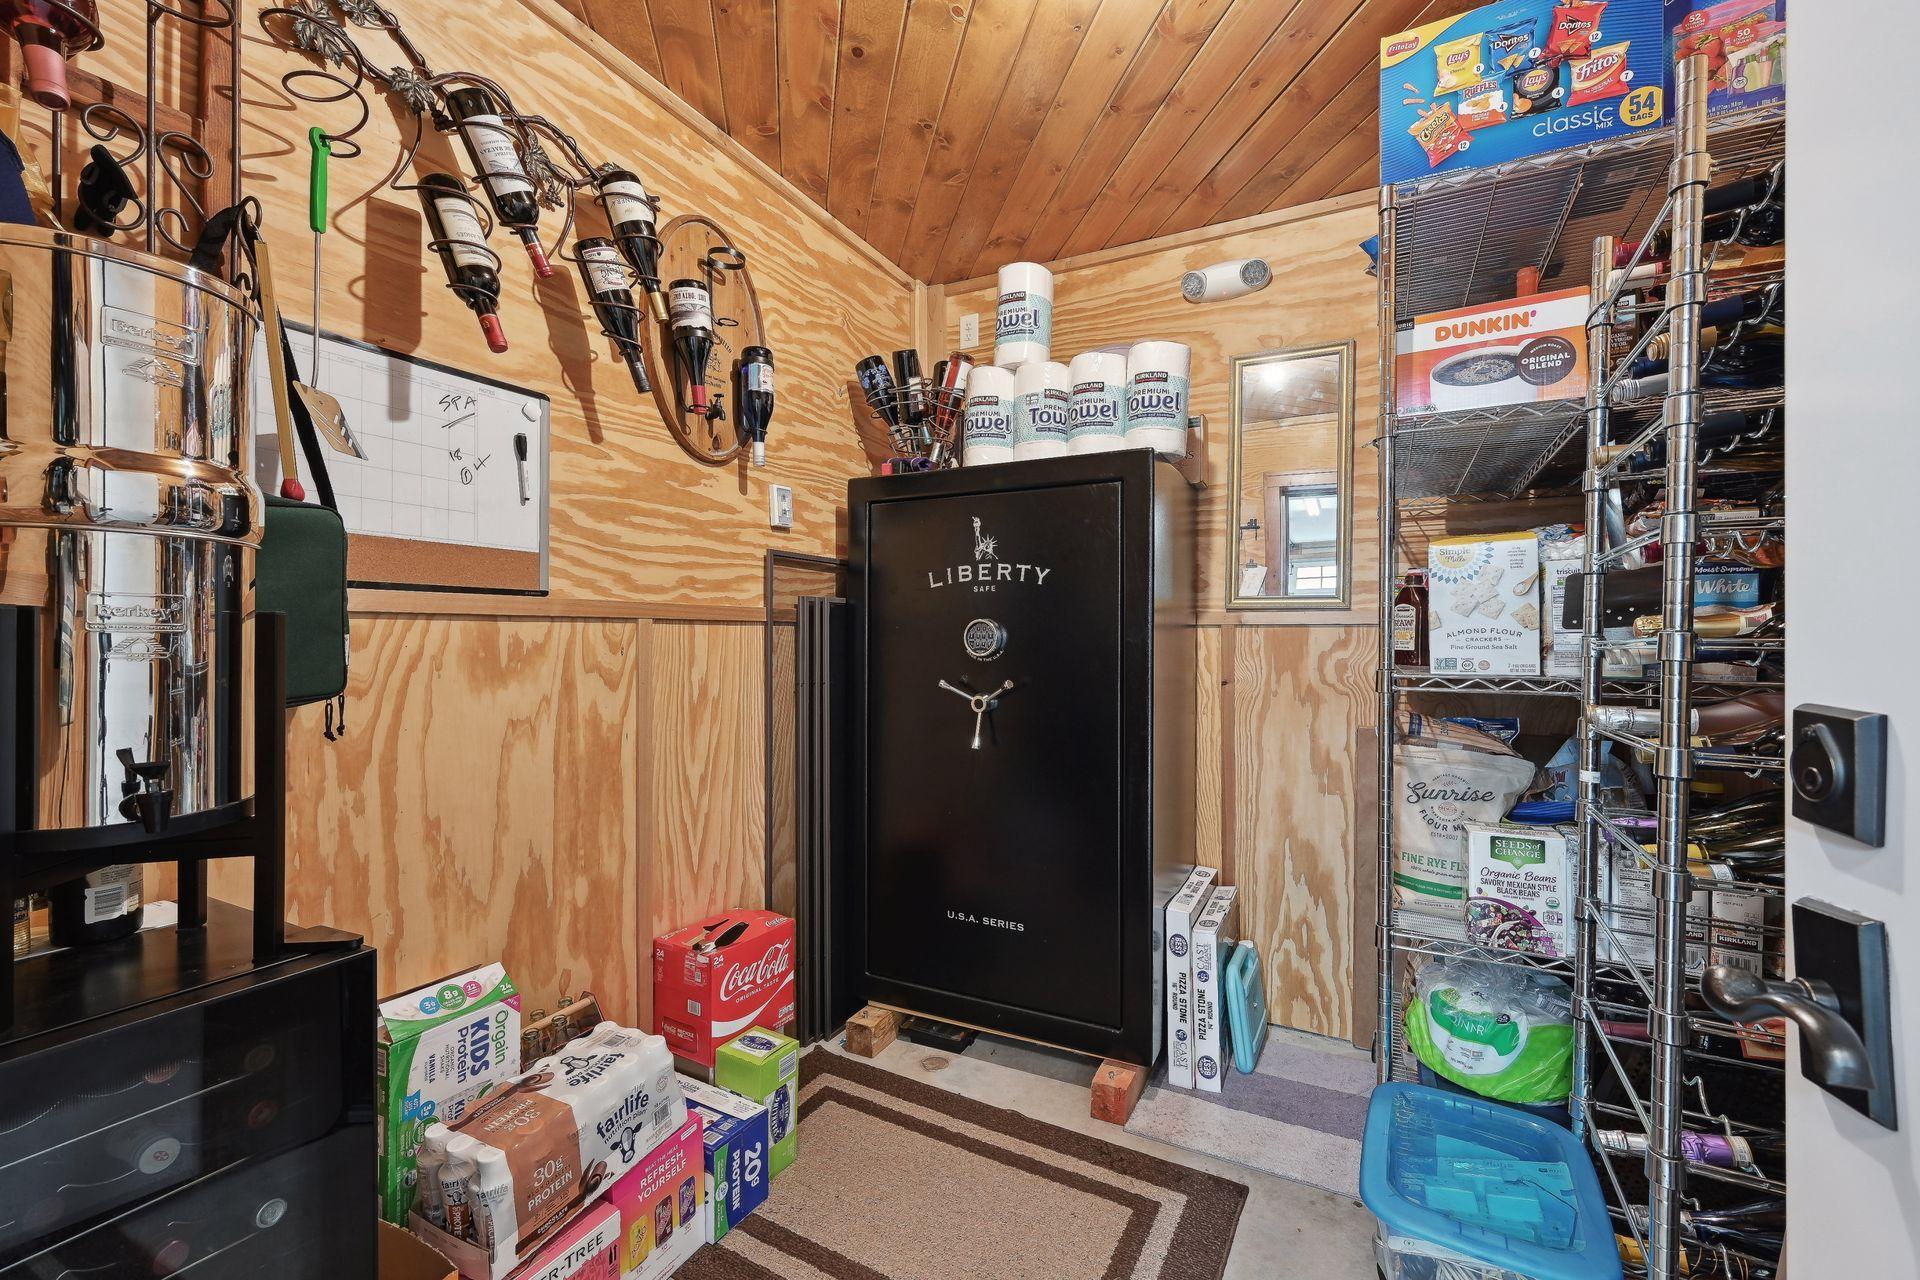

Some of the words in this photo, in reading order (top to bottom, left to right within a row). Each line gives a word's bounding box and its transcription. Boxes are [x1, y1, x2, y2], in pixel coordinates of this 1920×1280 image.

[1558, 20, 1592, 31] Doritos
[1689, 13, 1702, 22] 52
[1494, 33, 1529, 50] Doritos
[1591, 32, 1599, 41] 12
[1737, 28, 1751, 38] 50
[1577, 52, 1620, 82] Fritos
[1628, 91, 1656, 115] 54
[1532, 106, 1614, 138] classic
[1595, 121, 1613, 130] MIX
[1630, 111, 1654, 122] BAGS
[1521, 352, 1571, 365] ORIGINAL
[1529, 360, 1562, 370] BLEND
[1136, 371, 1168, 380] KIRKLAND
[439, 395, 476, 412] SPA
[1134, 388, 1168, 397] PREMIUM
[1439, 547, 1471, 556] Simple
[928, 563, 1051, 588] LIBERTY
[1696, 578, 1750, 594] White
[973, 585, 996, 593] SAFE
[96, 604, 172, 620] Berkey
[1446, 628, 1487, 639] ALMOND
[1490, 628, 1523, 638] FLOUR
[1406, 781, 1496, 805] Sunrise
[1419, 808, 1448, 832] FLOUR
[1495, 839, 1532, 849] SEEDS
[1532, 843, 1541, 851] of
[1495, 848, 1541, 858] CHANGE
[1402, 851, 1424, 866] FINE
[1427, 855, 1447, 871] RYE
[1480, 867, 1521, 879] Organic
[1524, 871, 1557, 884] Beans
[1480, 878, 1505, 887] SAVORY
[1506, 880, 1537, 890] MEXICAN
[1538, 884, 1557, 892] STYLE
[1496, 887, 1518, 896] BLACK
[1518, 889, 1541, 898] BEANS
[947, 910, 979, 923] U.S.A.
[982, 917, 1025, 932] SERIES
[1174, 937, 1183, 955] BEST
[1719, 935, 1757, 946] KIRKLAND
[656, 949, 665, 958] 24
[713, 955, 724, 965] 24
[1196, 942, 1204, 970] CAST
[735, 987, 762, 1004] ORIGINAL
[763, 976, 780, 989] TASTE
[1179, 972, 1187, 995] PIZZA
[1179, 998, 1187, 1024] STONE
[1197, 988, 1206, 1014] STONE
[491, 1009, 509, 1066] Orgain
[1198, 1017, 1206, 1041] PIZZA
[457, 1026, 469, 1084] Protein
[470, 1016, 490, 1076] KIDS
[1179, 1042, 1188, 1070] CAST
[428, 1054, 436, 1084] VANILLA
[568, 1053, 625, 1087] fairlife
[1203, 1058, 1211, 1076] BEST
[484, 1099, 534, 1132] PROTEIN
[597, 1091, 650, 1140] fairlife
[604, 1116, 634, 1144] nutrition
[632, 1108, 648, 1121] plan
[533, 1157, 564, 1187] 30g
[640, 1149, 684, 1189] REFRESH
[744, 1141, 762, 1187] 20g
[528, 1171, 573, 1211] PROTEIN
[637, 1158, 687, 1203] YOURSELF
[732, 1149, 740, 1211] PROTEIN
[537, 1206, 568, 1234] CHOCOLATE
